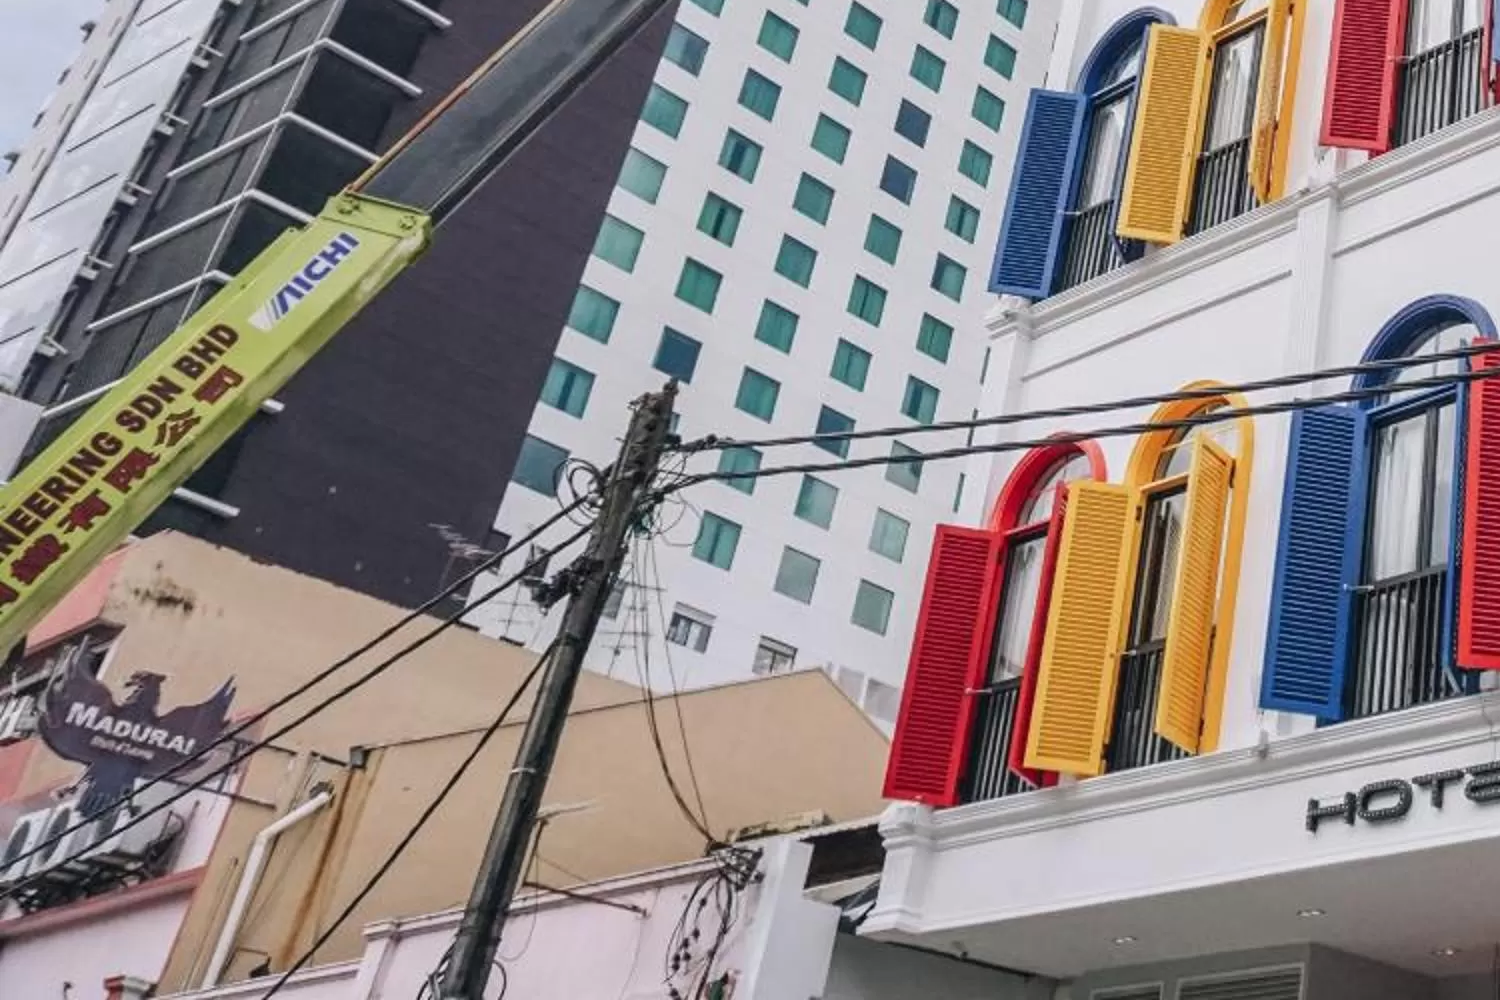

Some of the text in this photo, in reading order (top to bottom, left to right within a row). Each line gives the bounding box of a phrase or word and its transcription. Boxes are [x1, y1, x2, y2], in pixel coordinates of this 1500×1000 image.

[273, 232, 360, 318] AICHI
[0, 323, 240, 562] NEERING SDN BHD
[65, 701, 197, 756] MADURAI
